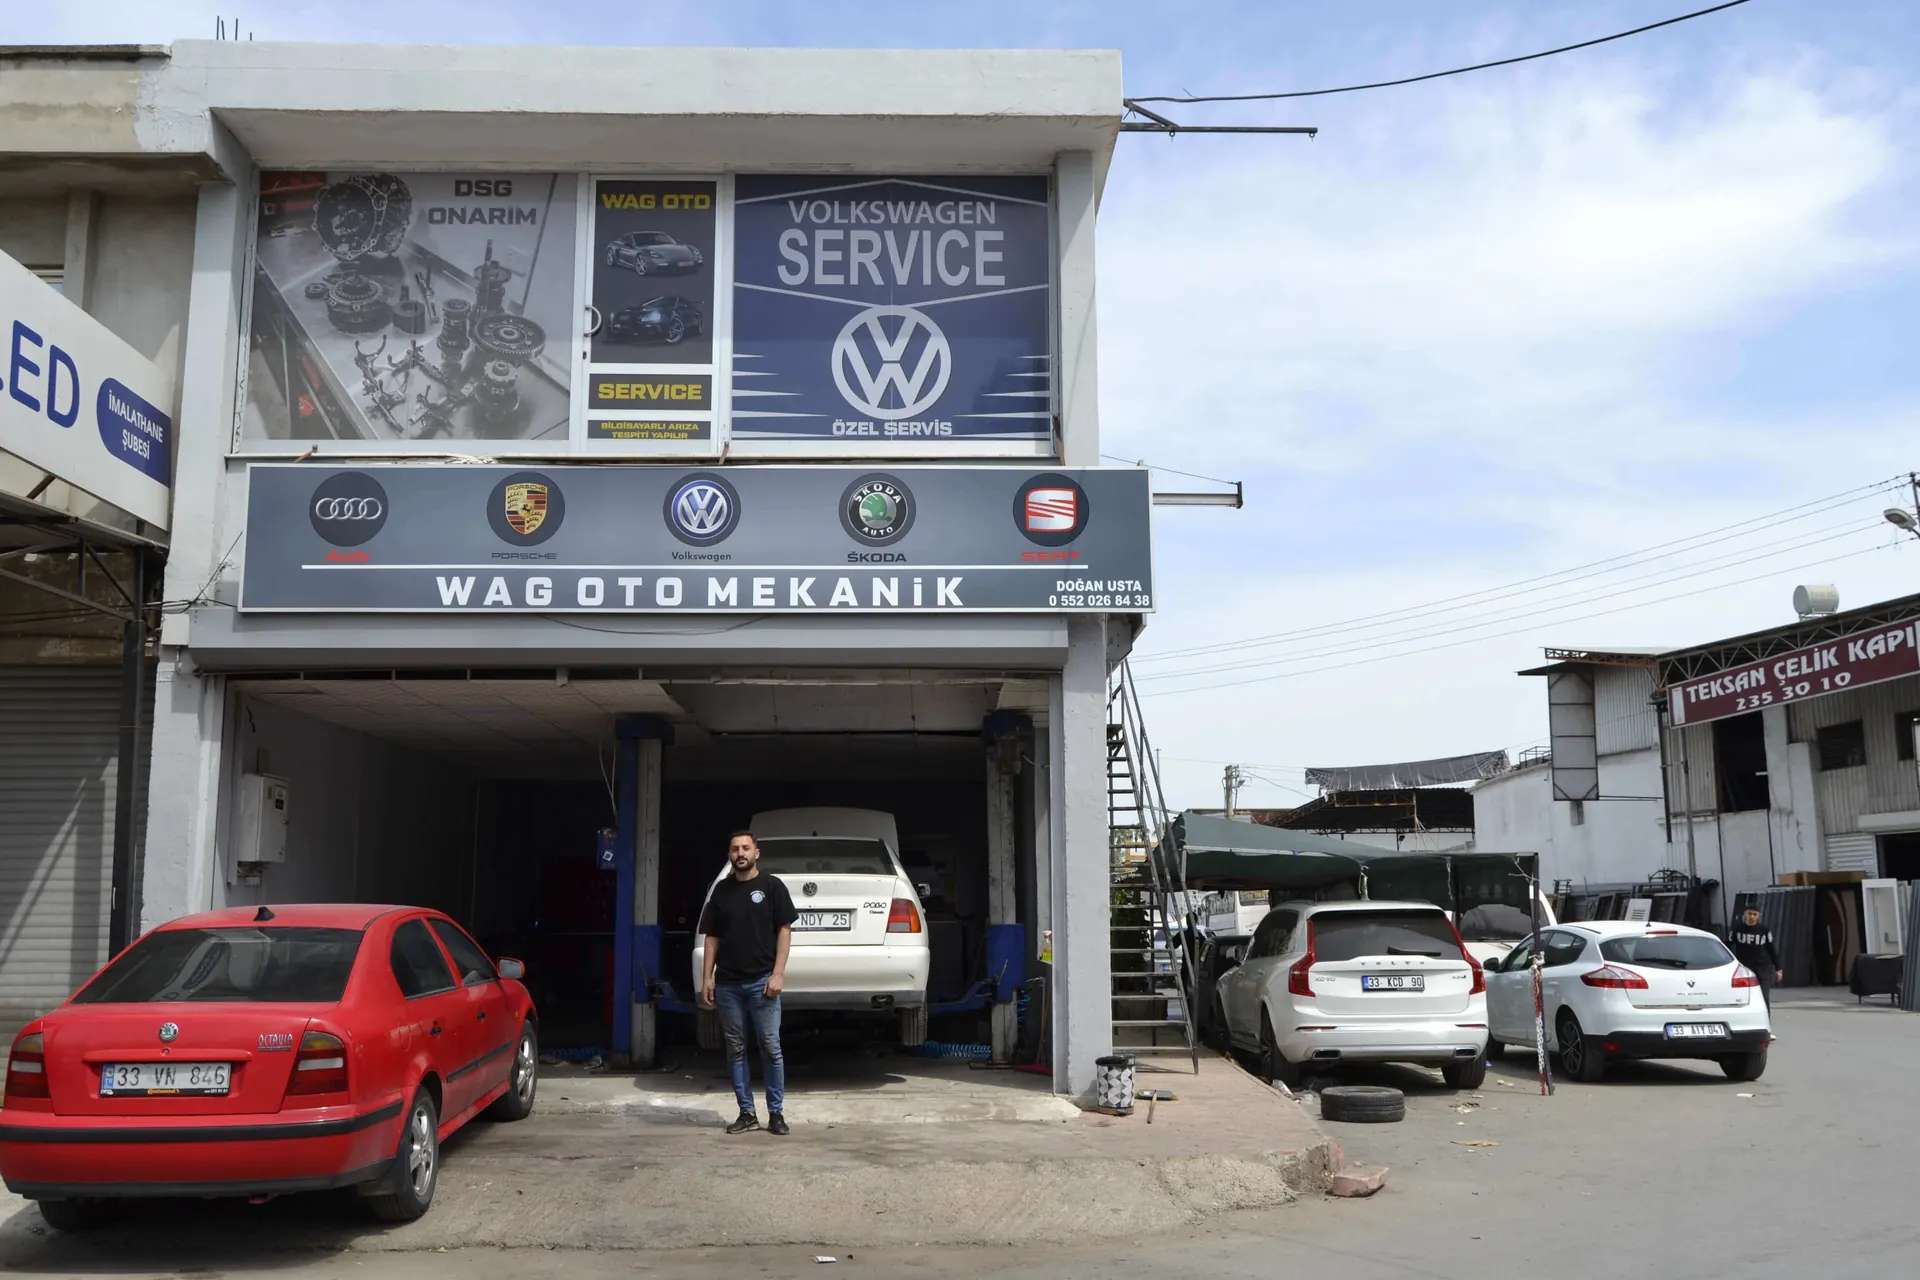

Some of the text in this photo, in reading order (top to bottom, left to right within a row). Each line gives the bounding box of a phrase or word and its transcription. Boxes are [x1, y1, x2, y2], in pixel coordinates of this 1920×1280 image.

[454, 179, 512, 197] DSG
[602, 193, 711, 209] WAG OTO
[428, 206, 537, 225] ONARIM
[788, 200, 996, 224] VOLKSWAGEN
[777, 228, 1005, 286] SERVICE
[0, 320, 80, 429] ED
[598, 383, 702, 400] SERVICE
[109, 389, 163, 443] İMALATHANE
[651, 431, 688, 439] YAPILIR
[832, 419, 952, 436] ÖZEL SERVİS
[122, 429, 150, 460] ŞUBESİ
[862, 526, 894, 535] AUTO
[324, 549, 371, 563] Audi
[491, 552, 557, 560] PORSCHE
[671, 551, 732, 562] Volkswagen
[847, 551, 907, 563] ŠKODA
[1021, 551, 1083, 562] SEAT
[435, 576, 552, 606] WAG
[577, 577, 684, 606] OTO
[1056, 578, 1143, 592] DOĞAN USTA
[1049, 595, 1150, 606] 0 552 026 84 38
[1686, 627, 1914, 703] TEKSAN ÇELİK KAPI
[1736, 672, 1852, 711] 235 30 10
[800, 914, 848, 926] NDY 25
[1368, 976, 1422, 988] 33 KCD 90
[1673, 1026, 1685, 1035] 33
[258, 1033, 293, 1046] OCTAVIA
[117, 1066, 225, 1087] 33 VN 846
